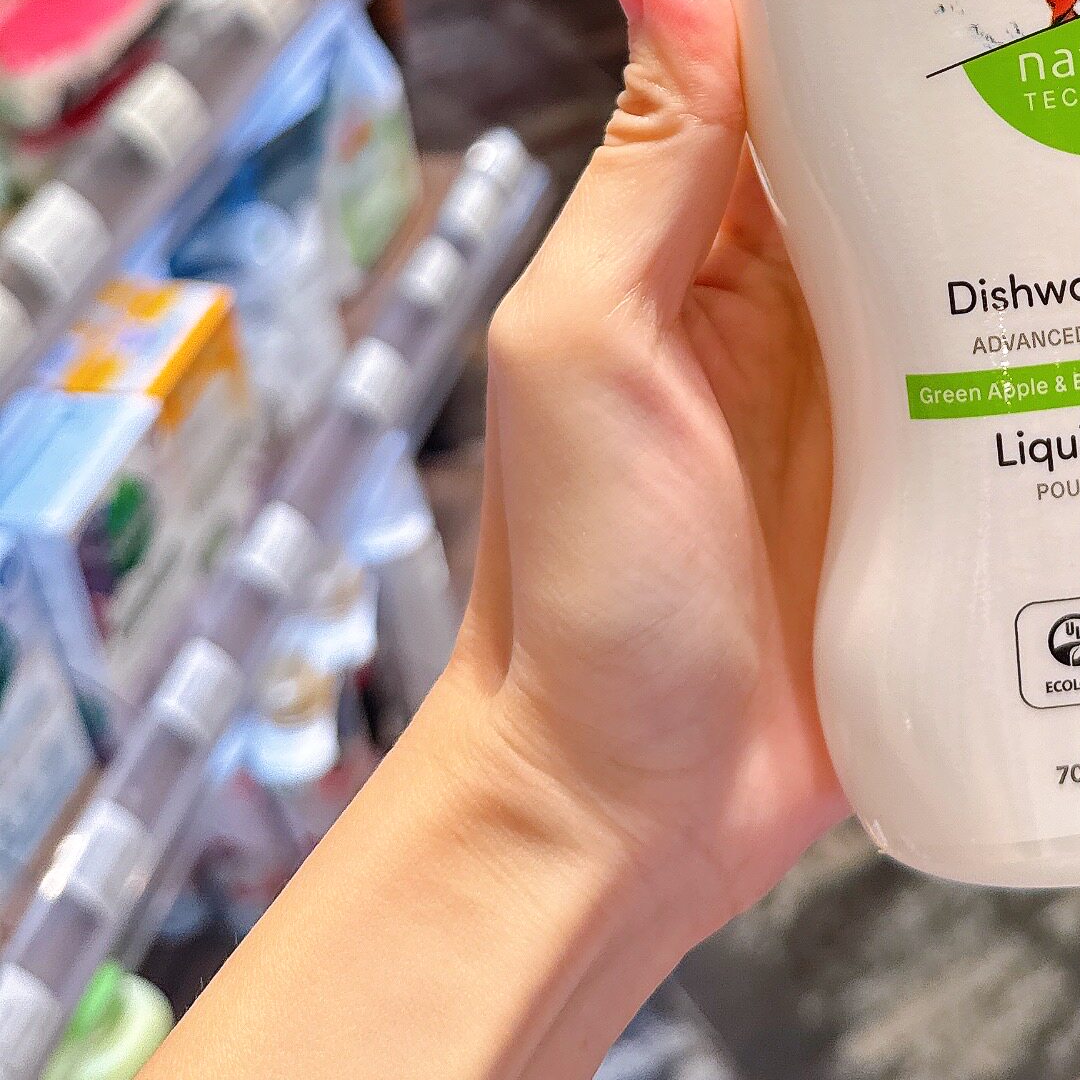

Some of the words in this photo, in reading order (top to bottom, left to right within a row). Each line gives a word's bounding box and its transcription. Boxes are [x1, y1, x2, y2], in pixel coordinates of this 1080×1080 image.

[919, 384, 982, 405] Green
[987, 377, 1049, 403] Apple
[1054, 376, 1068, 394] &
